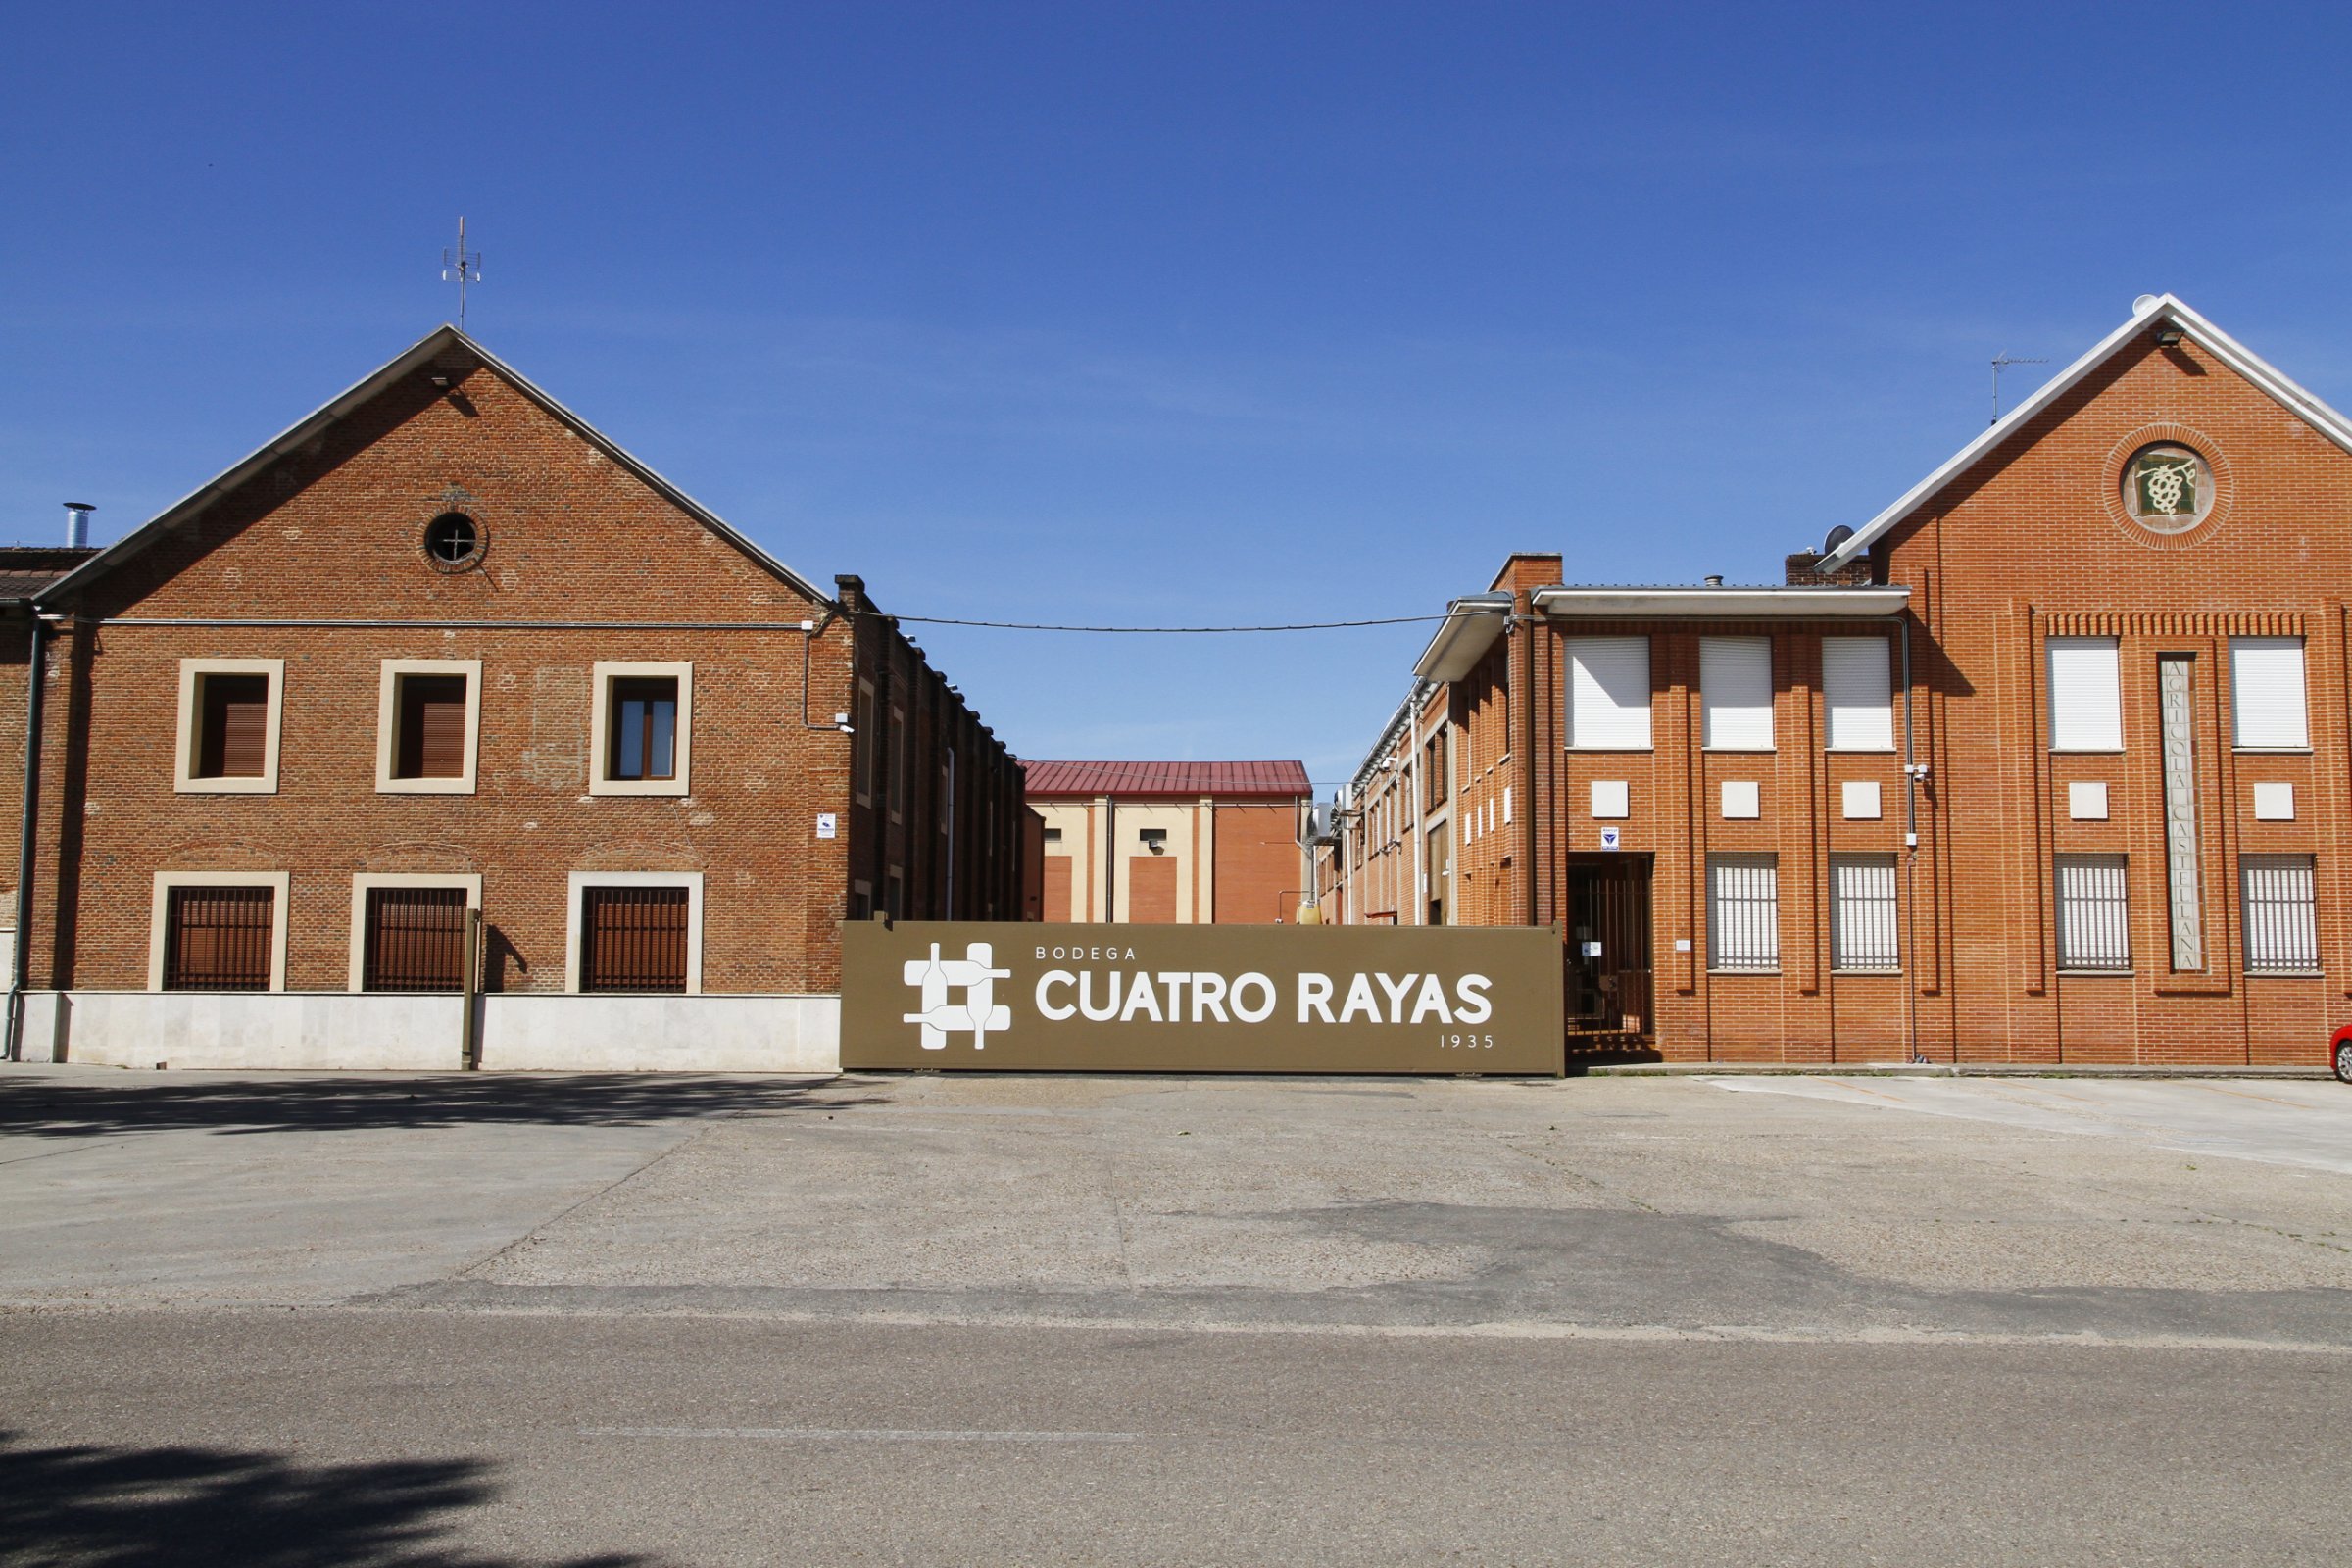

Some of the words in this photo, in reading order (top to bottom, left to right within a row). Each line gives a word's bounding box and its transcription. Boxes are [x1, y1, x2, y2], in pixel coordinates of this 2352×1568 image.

[2168, 661, 2185, 788] AGRICOLA
[2173, 805, 2194, 968] CASTELLANA
[1035, 946, 1137, 960] BODEGA
[1035, 969, 1277, 1024] CUATRO
[1298, 972, 1493, 1025] RAYAS
[1441, 1034, 1494, 1049] 1935
